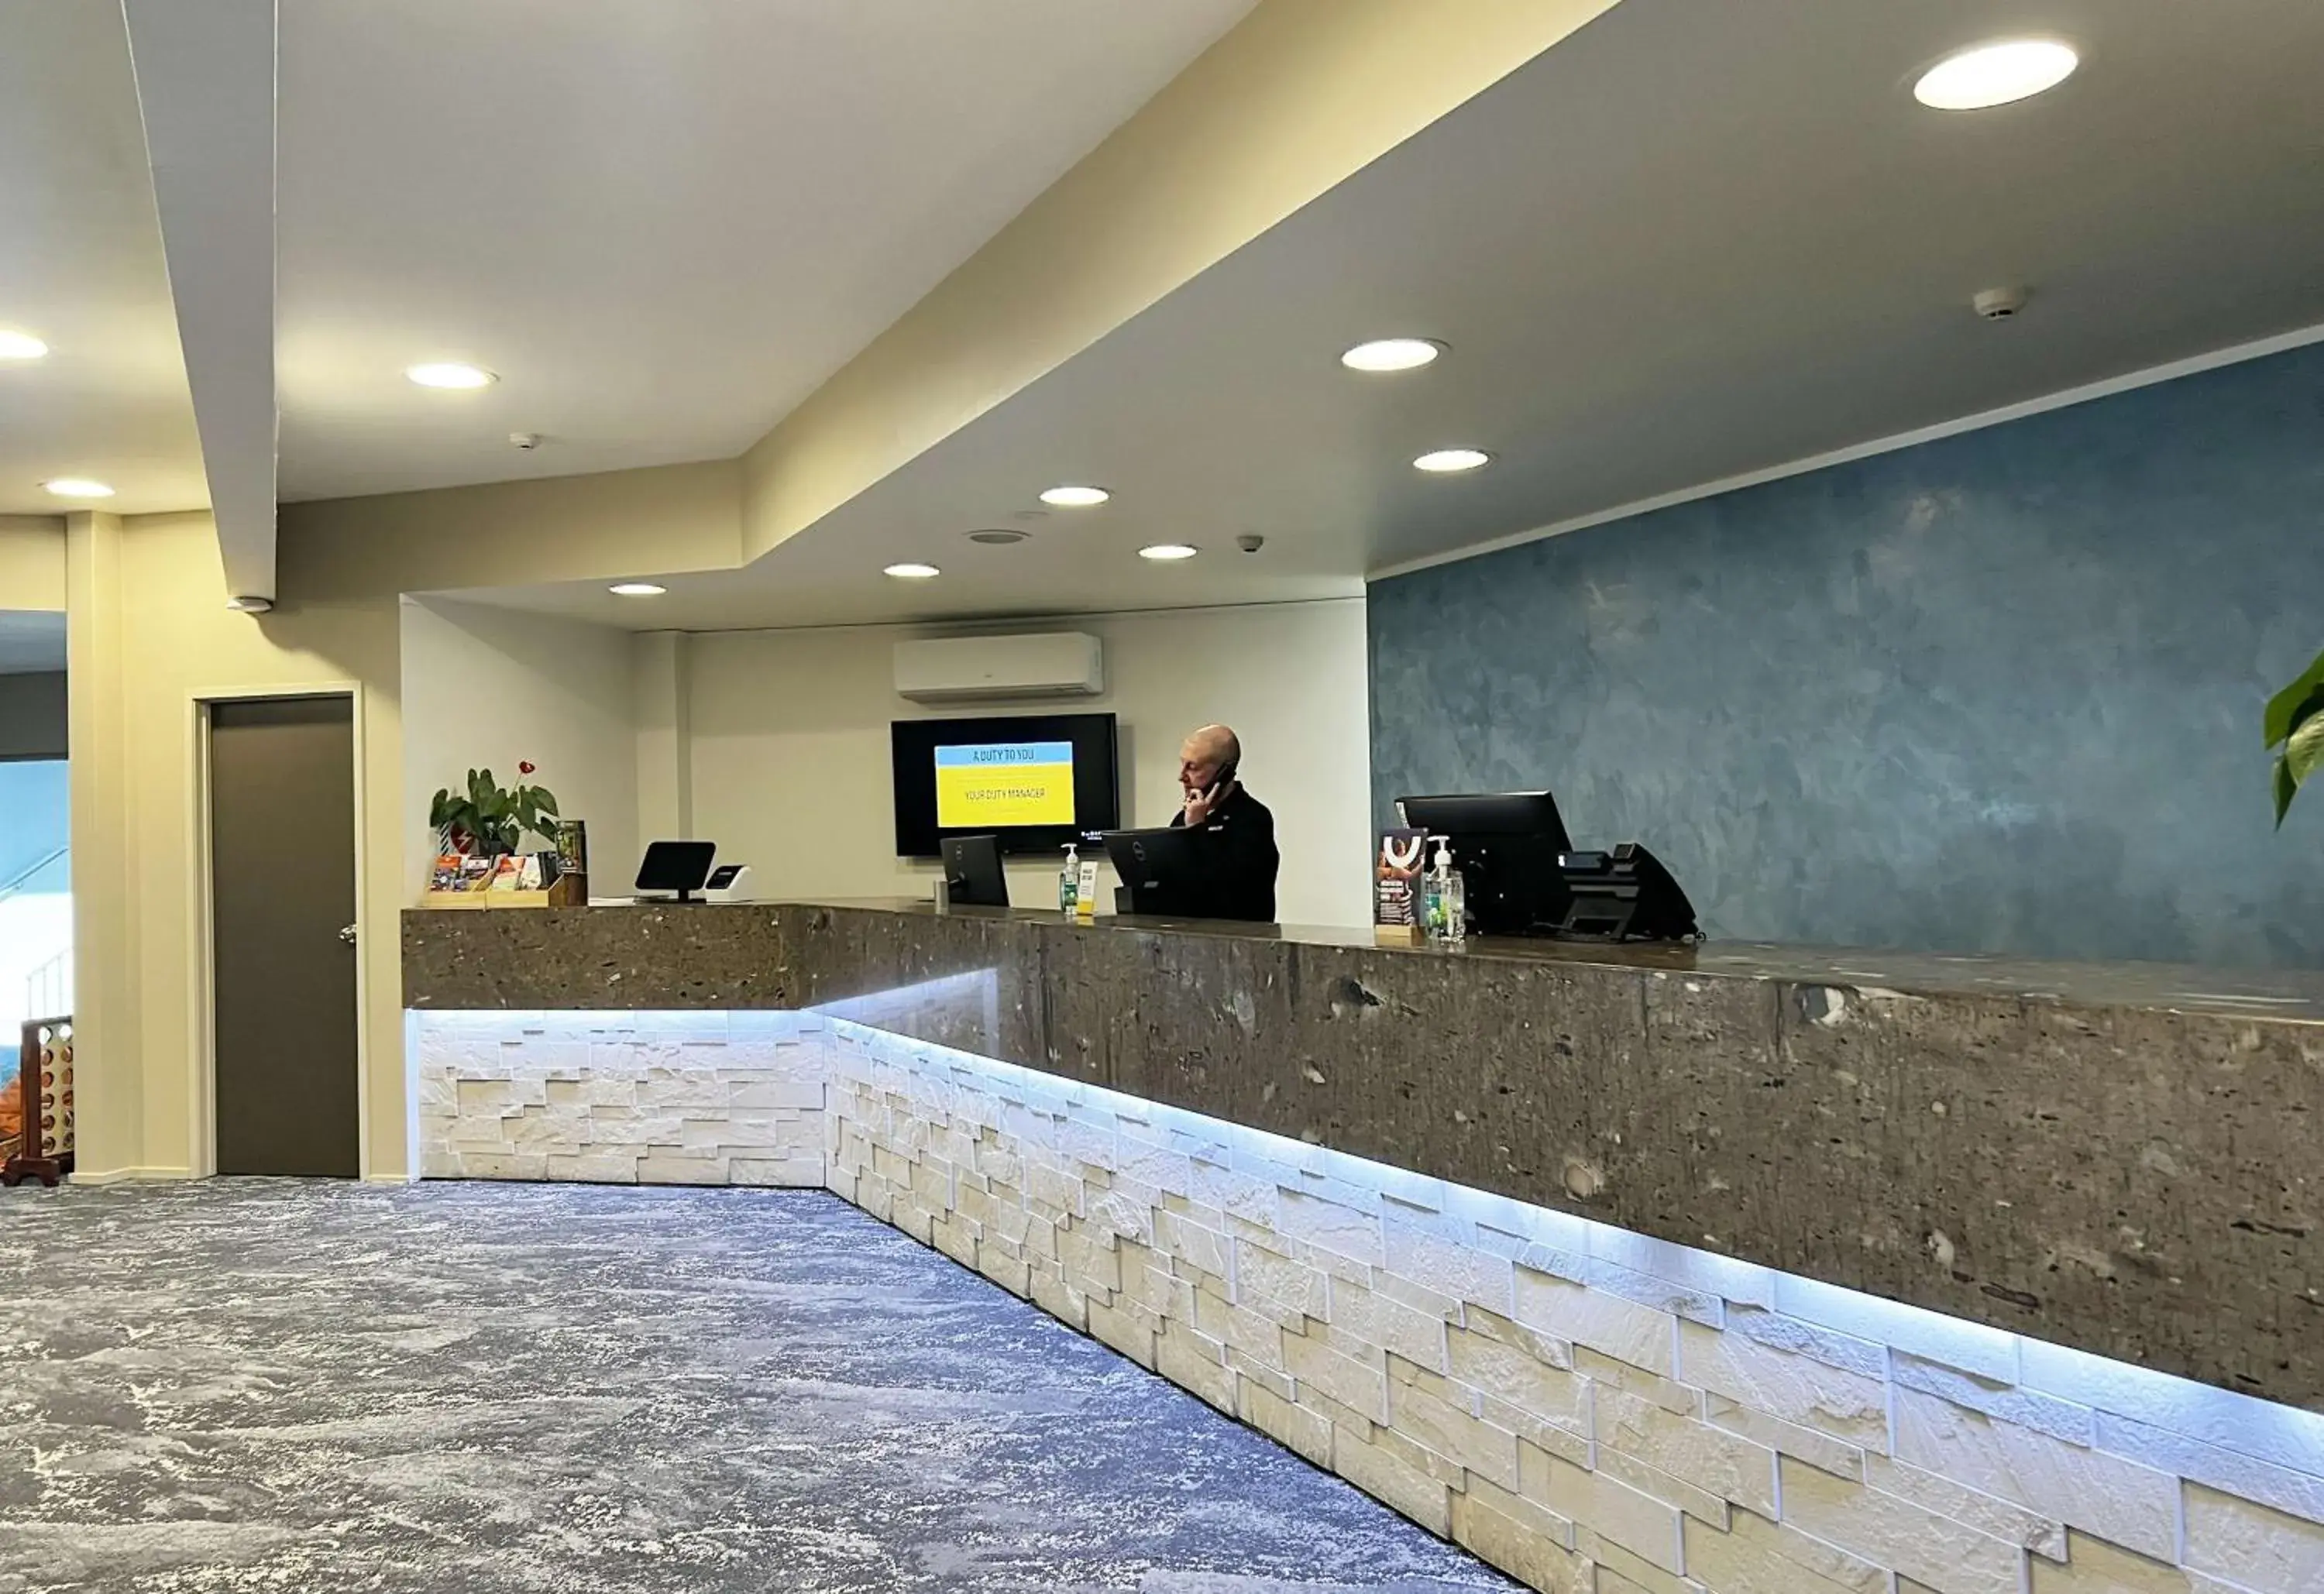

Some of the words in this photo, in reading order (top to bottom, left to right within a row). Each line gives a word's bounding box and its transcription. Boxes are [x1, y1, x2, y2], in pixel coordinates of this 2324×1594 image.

[973, 750, 980, 761] A
[981, 749, 1003, 761] DUTY
[1006, 749, 1016, 760] TO
[1017, 748, 1034, 760] YOU
[965, 790, 985, 800] YOUR
[1008, 788, 1045, 799] MANAGER
